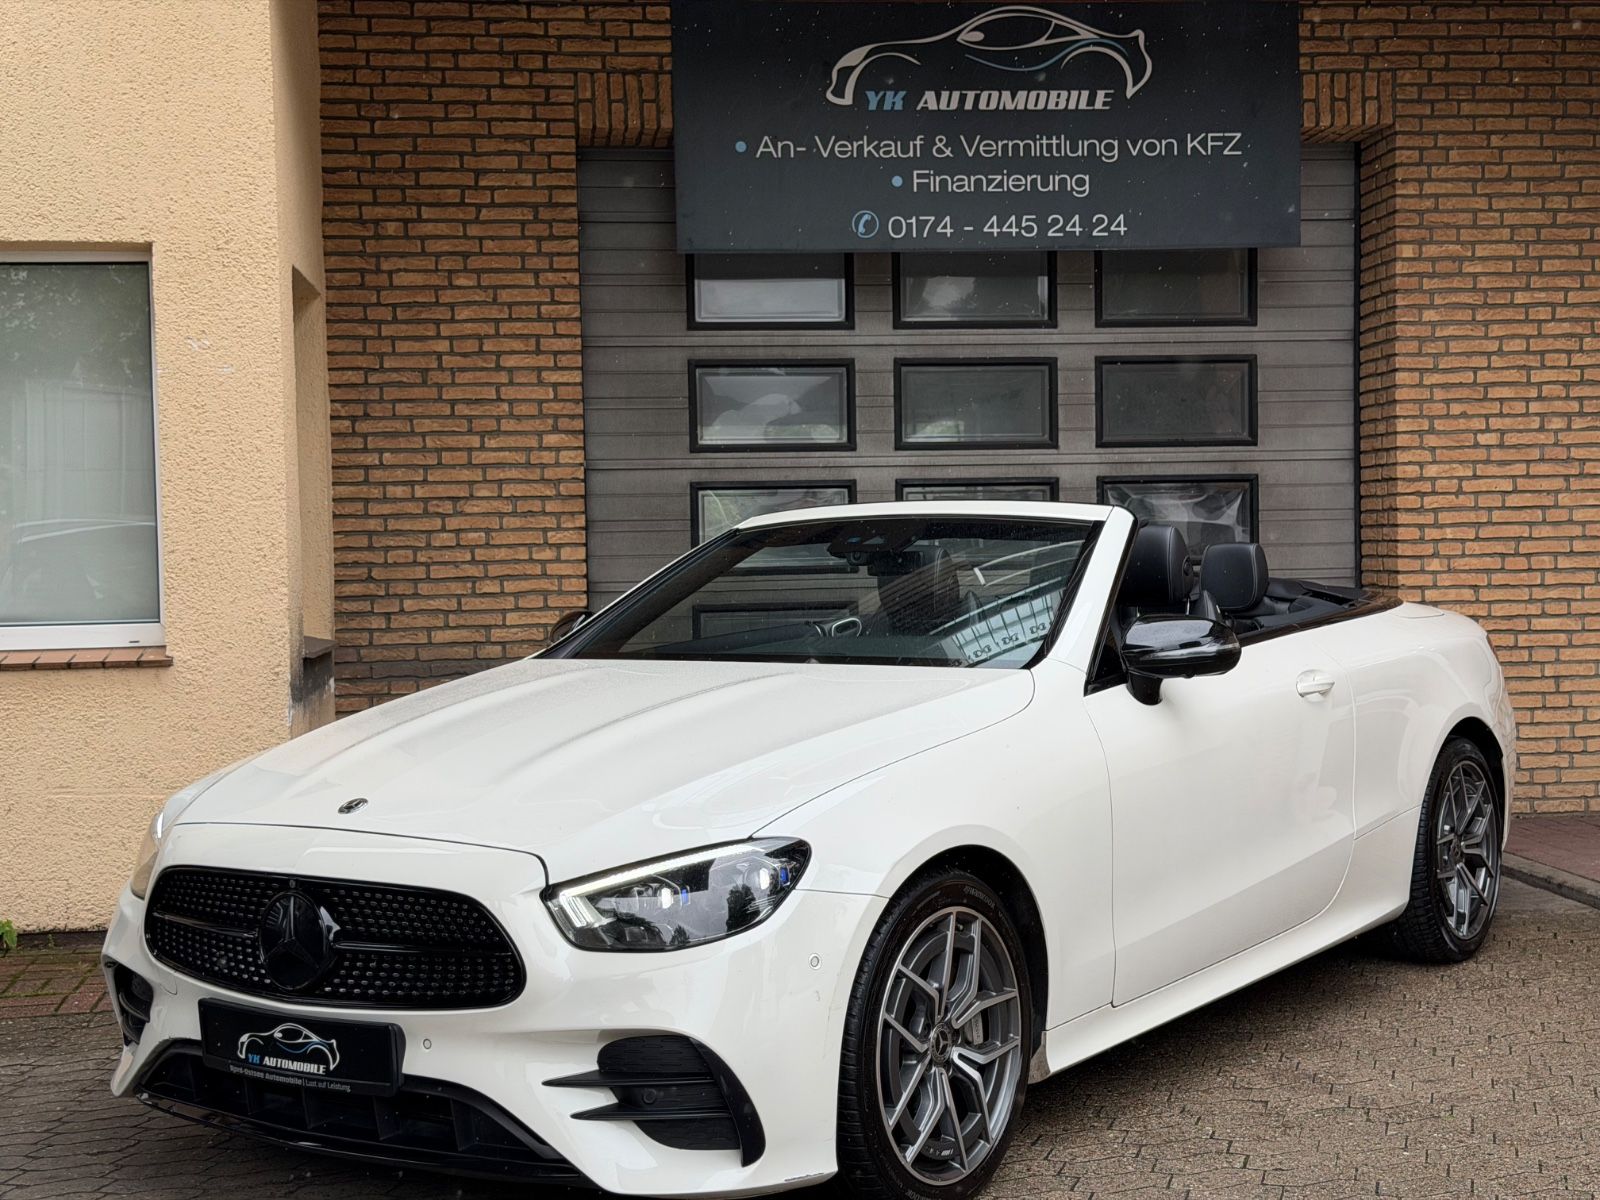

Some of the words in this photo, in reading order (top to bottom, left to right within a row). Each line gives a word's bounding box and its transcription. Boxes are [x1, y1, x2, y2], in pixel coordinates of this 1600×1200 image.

[865, 90, 907, 111] YK
[916, 89, 1115, 111] AUTOMOBILE
[755, 135, 807, 158] An-
[814, 135, 925, 158] Verkauf
[932, 135, 954, 158] &
[959, 134, 1119, 163] Vermittlung
[1126, 138, 1178, 156] von
[1187, 132, 1243, 156] KFZ
[912, 169, 1090, 198] Finanzierung
[888, 215, 954, 238] 0174
[983, 214, 1038, 237] 445
[1047, 214, 1084, 237] 24
[1092, 213, 1128, 236] 24
[247, 1053, 261, 1065] YK
[262, 1058, 326, 1075] AUTOMOBILE
